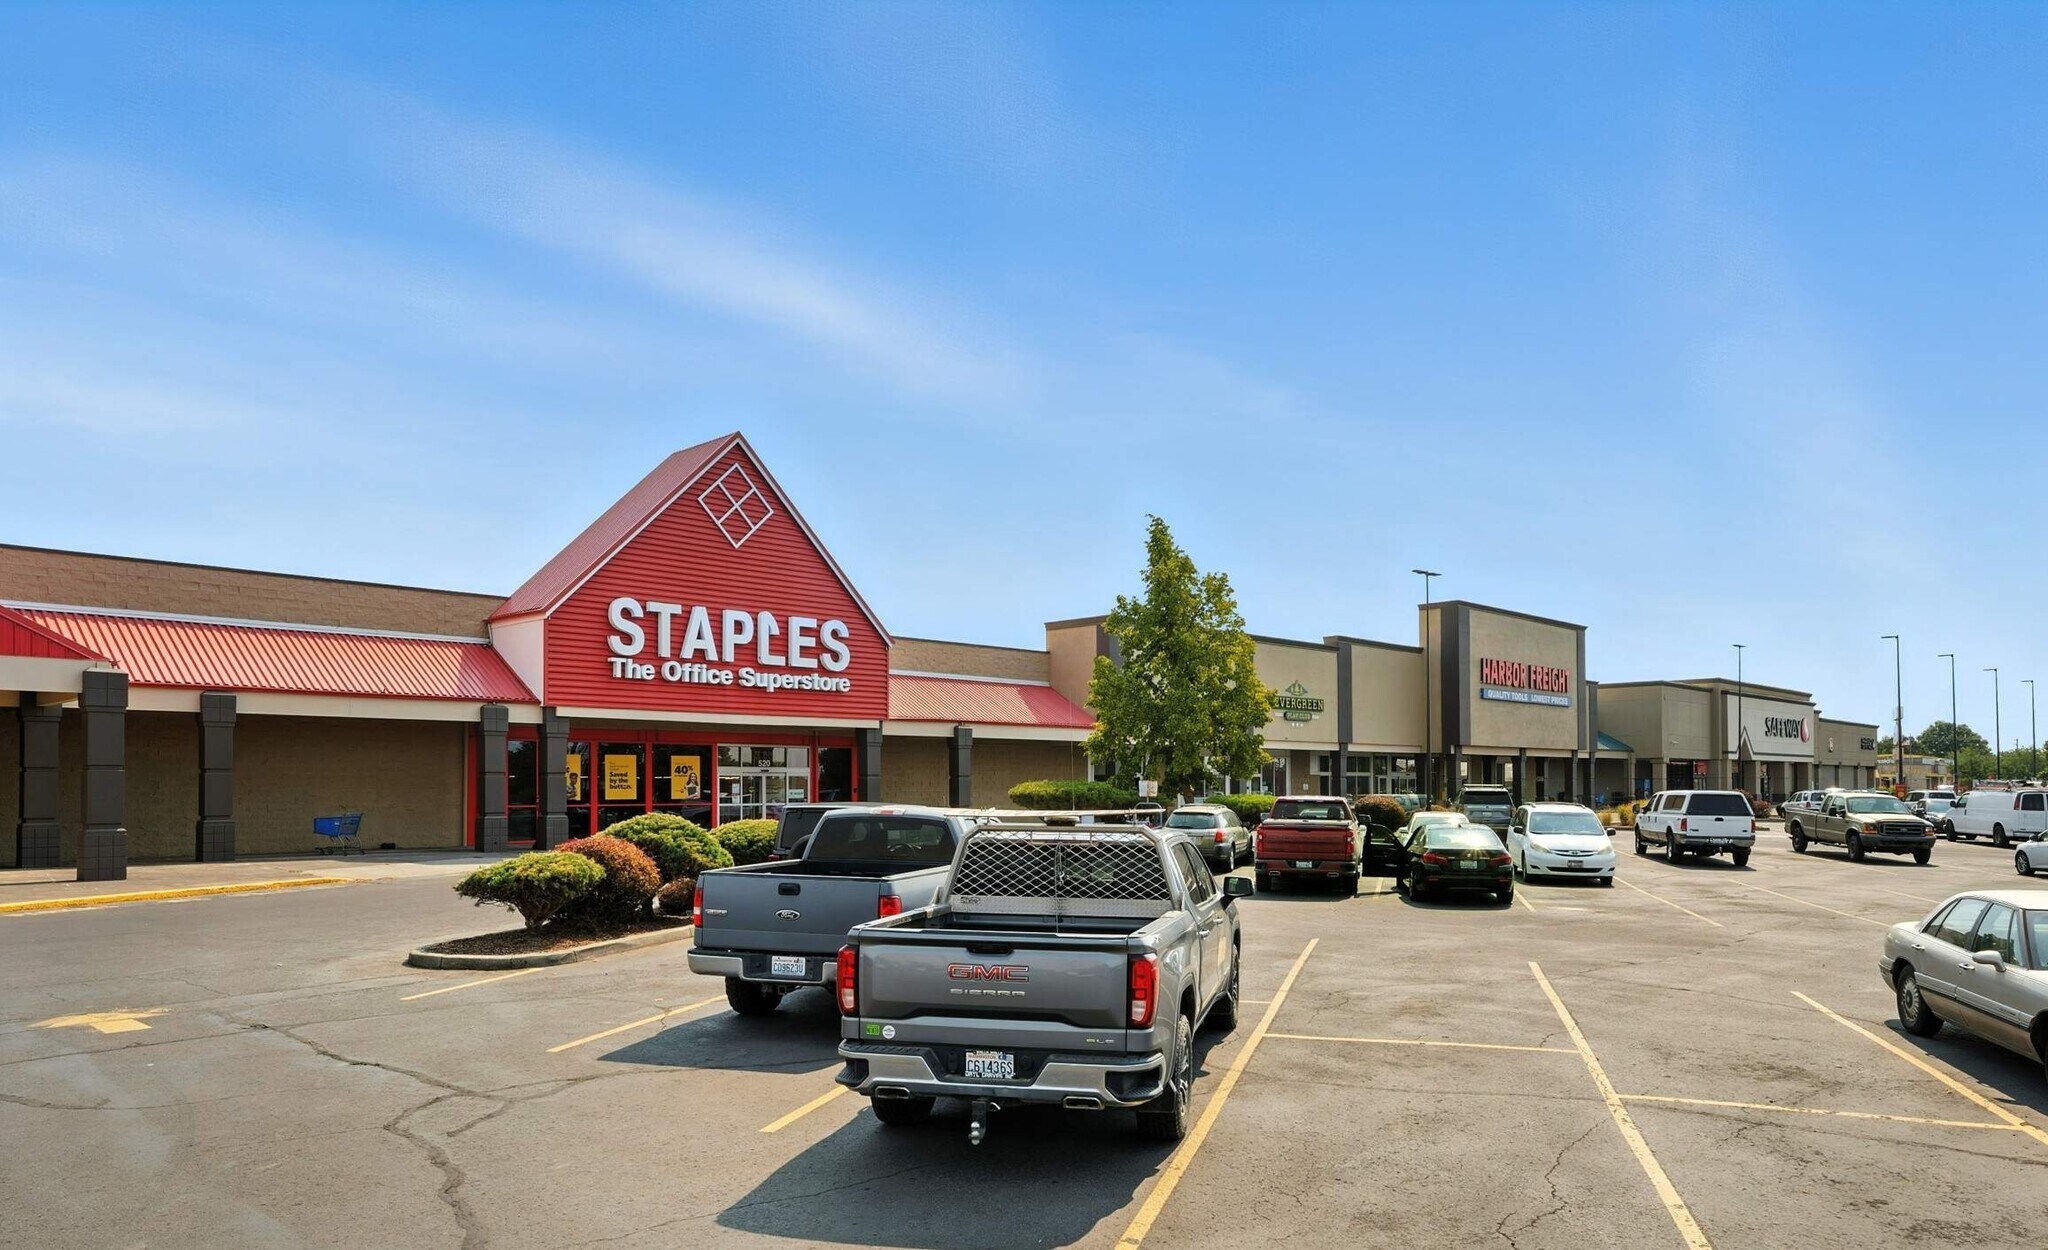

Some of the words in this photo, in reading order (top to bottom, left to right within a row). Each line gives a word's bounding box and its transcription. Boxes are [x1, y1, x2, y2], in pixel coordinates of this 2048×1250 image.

[607, 596, 851, 672] STAPLES
[608, 657, 656, 681] The
[661, 661, 734, 686] Office
[738, 667, 851, 693] Superstore
[1481, 658, 1527, 689] HARBOR
[1528, 664, 1570, 694] FREIGHT
[1487, 689, 1511, 701] QUALITY
[1511, 692, 1528, 702] TOOLS
[1765, 716, 1801, 739] SAFEWAY
[674, 764, 694, 775] 40%
[758, 759, 771, 768] 520
[947, 963, 1030, 983] GMC
[950, 988, 1026, 997] SIERRA
[967, 1060, 1013, 1075] C61436S
